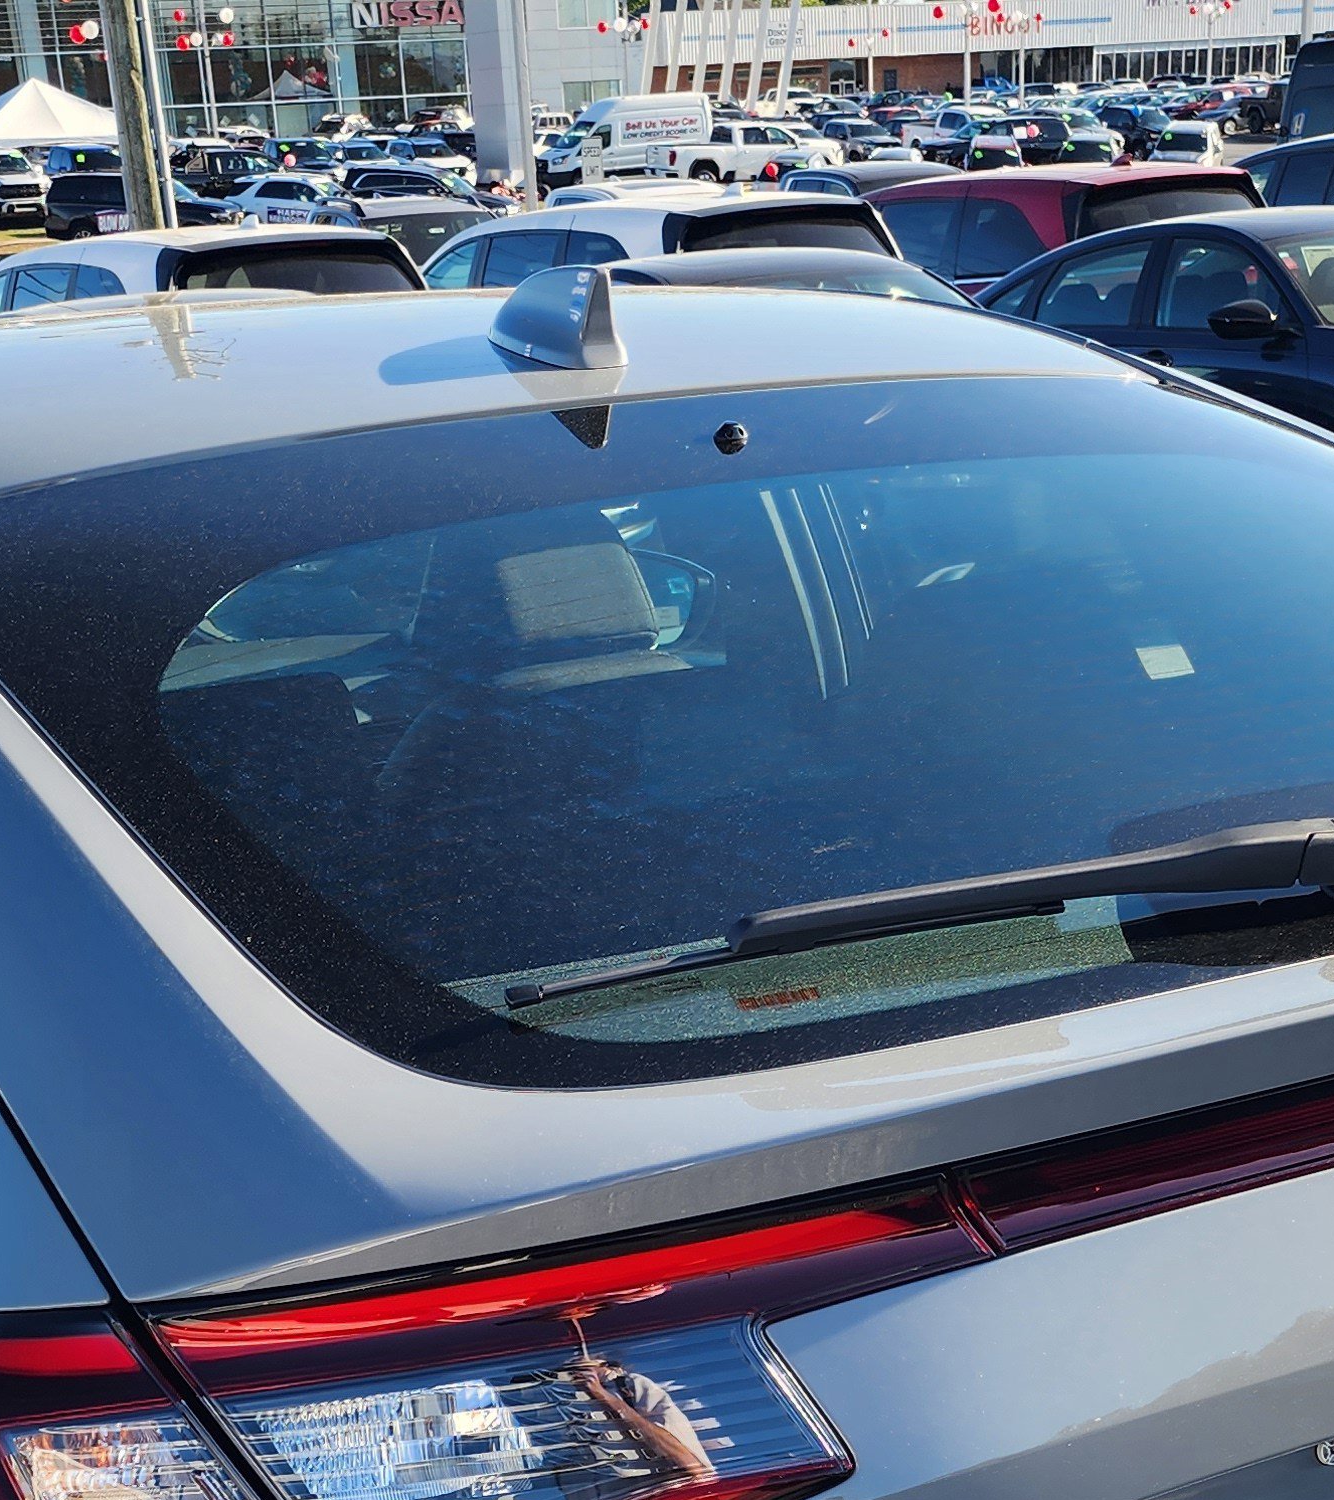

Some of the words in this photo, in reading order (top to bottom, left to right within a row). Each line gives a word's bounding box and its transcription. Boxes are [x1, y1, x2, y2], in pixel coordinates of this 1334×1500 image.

[351, 0, 465, 28] NISSA
[625, 121, 643, 131] Sell
[645, 120, 657, 129] Us
[660, 118, 680, 128] Your
[682, 117, 698, 126] Car
[640, 130, 664, 138] CREDIT
